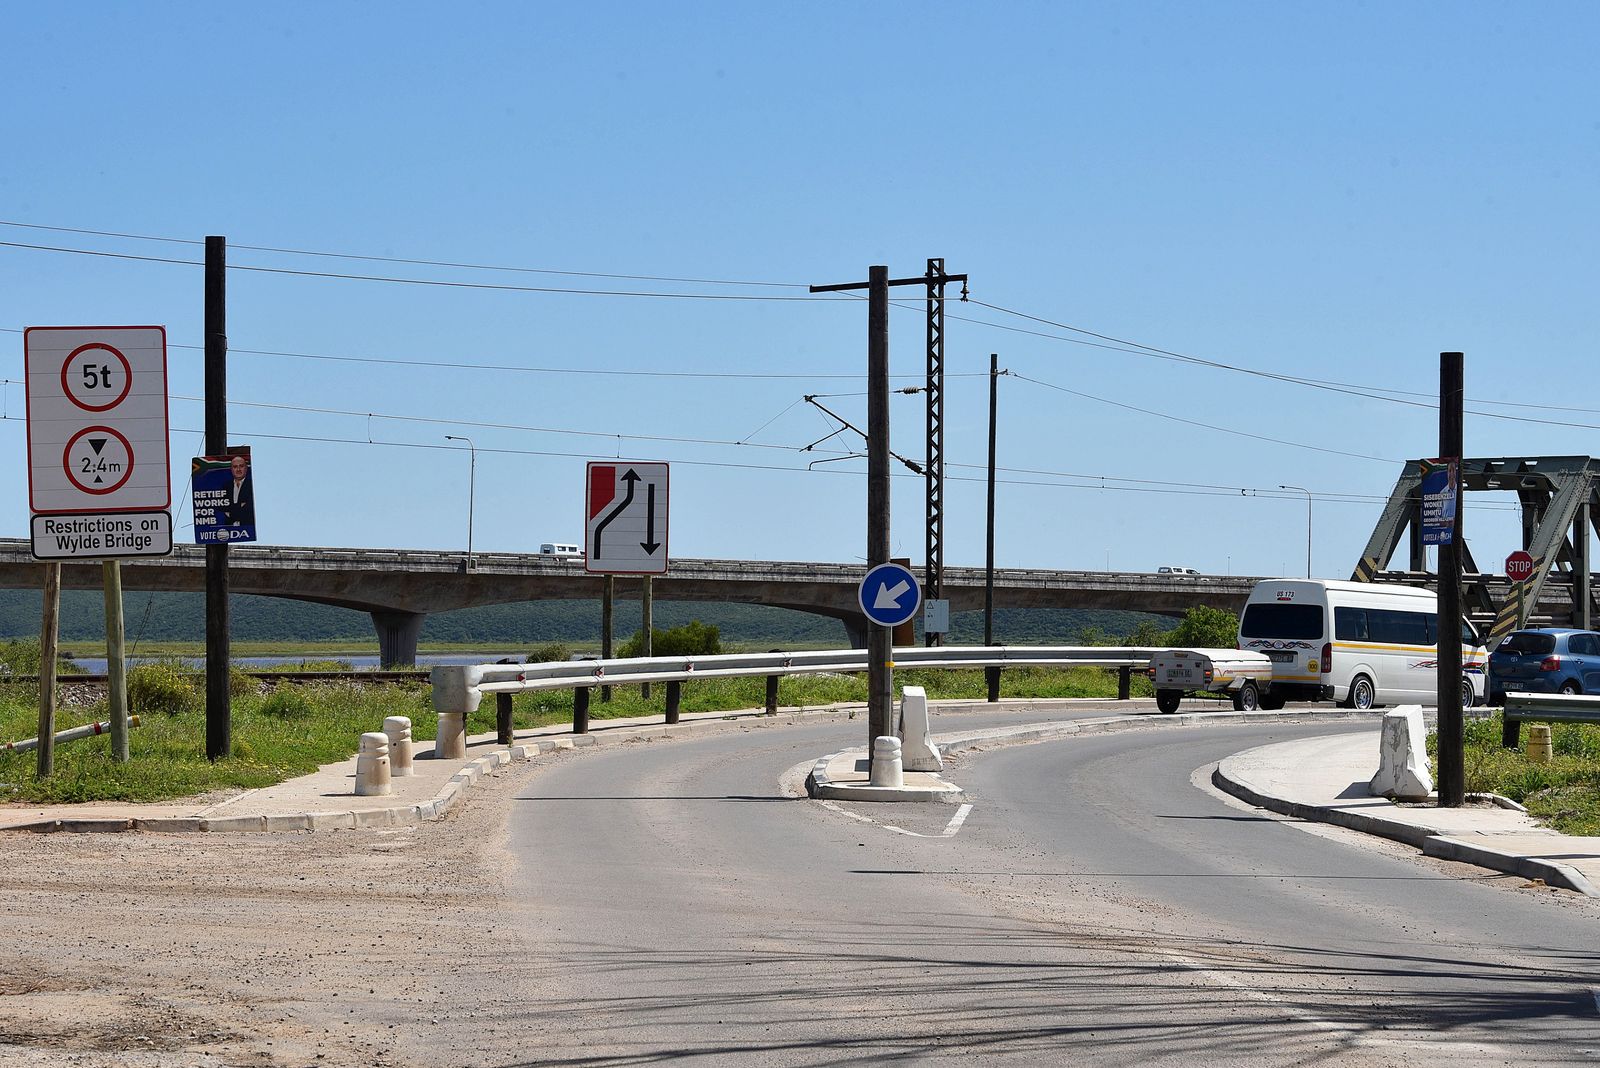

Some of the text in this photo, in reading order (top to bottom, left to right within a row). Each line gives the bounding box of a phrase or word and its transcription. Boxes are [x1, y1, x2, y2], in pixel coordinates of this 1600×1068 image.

[82, 364, 112, 389] 5t
[194, 490, 227, 498] RETIEF
[194, 499, 230, 507] WORKS
[45, 518, 159, 534] Restrictions on
[195, 517, 217, 525] NMB
[200, 530, 250, 540] VOTE DA
[56, 533, 152, 553] Wylde Bridge
[1508, 561, 1531, 572] STOP
